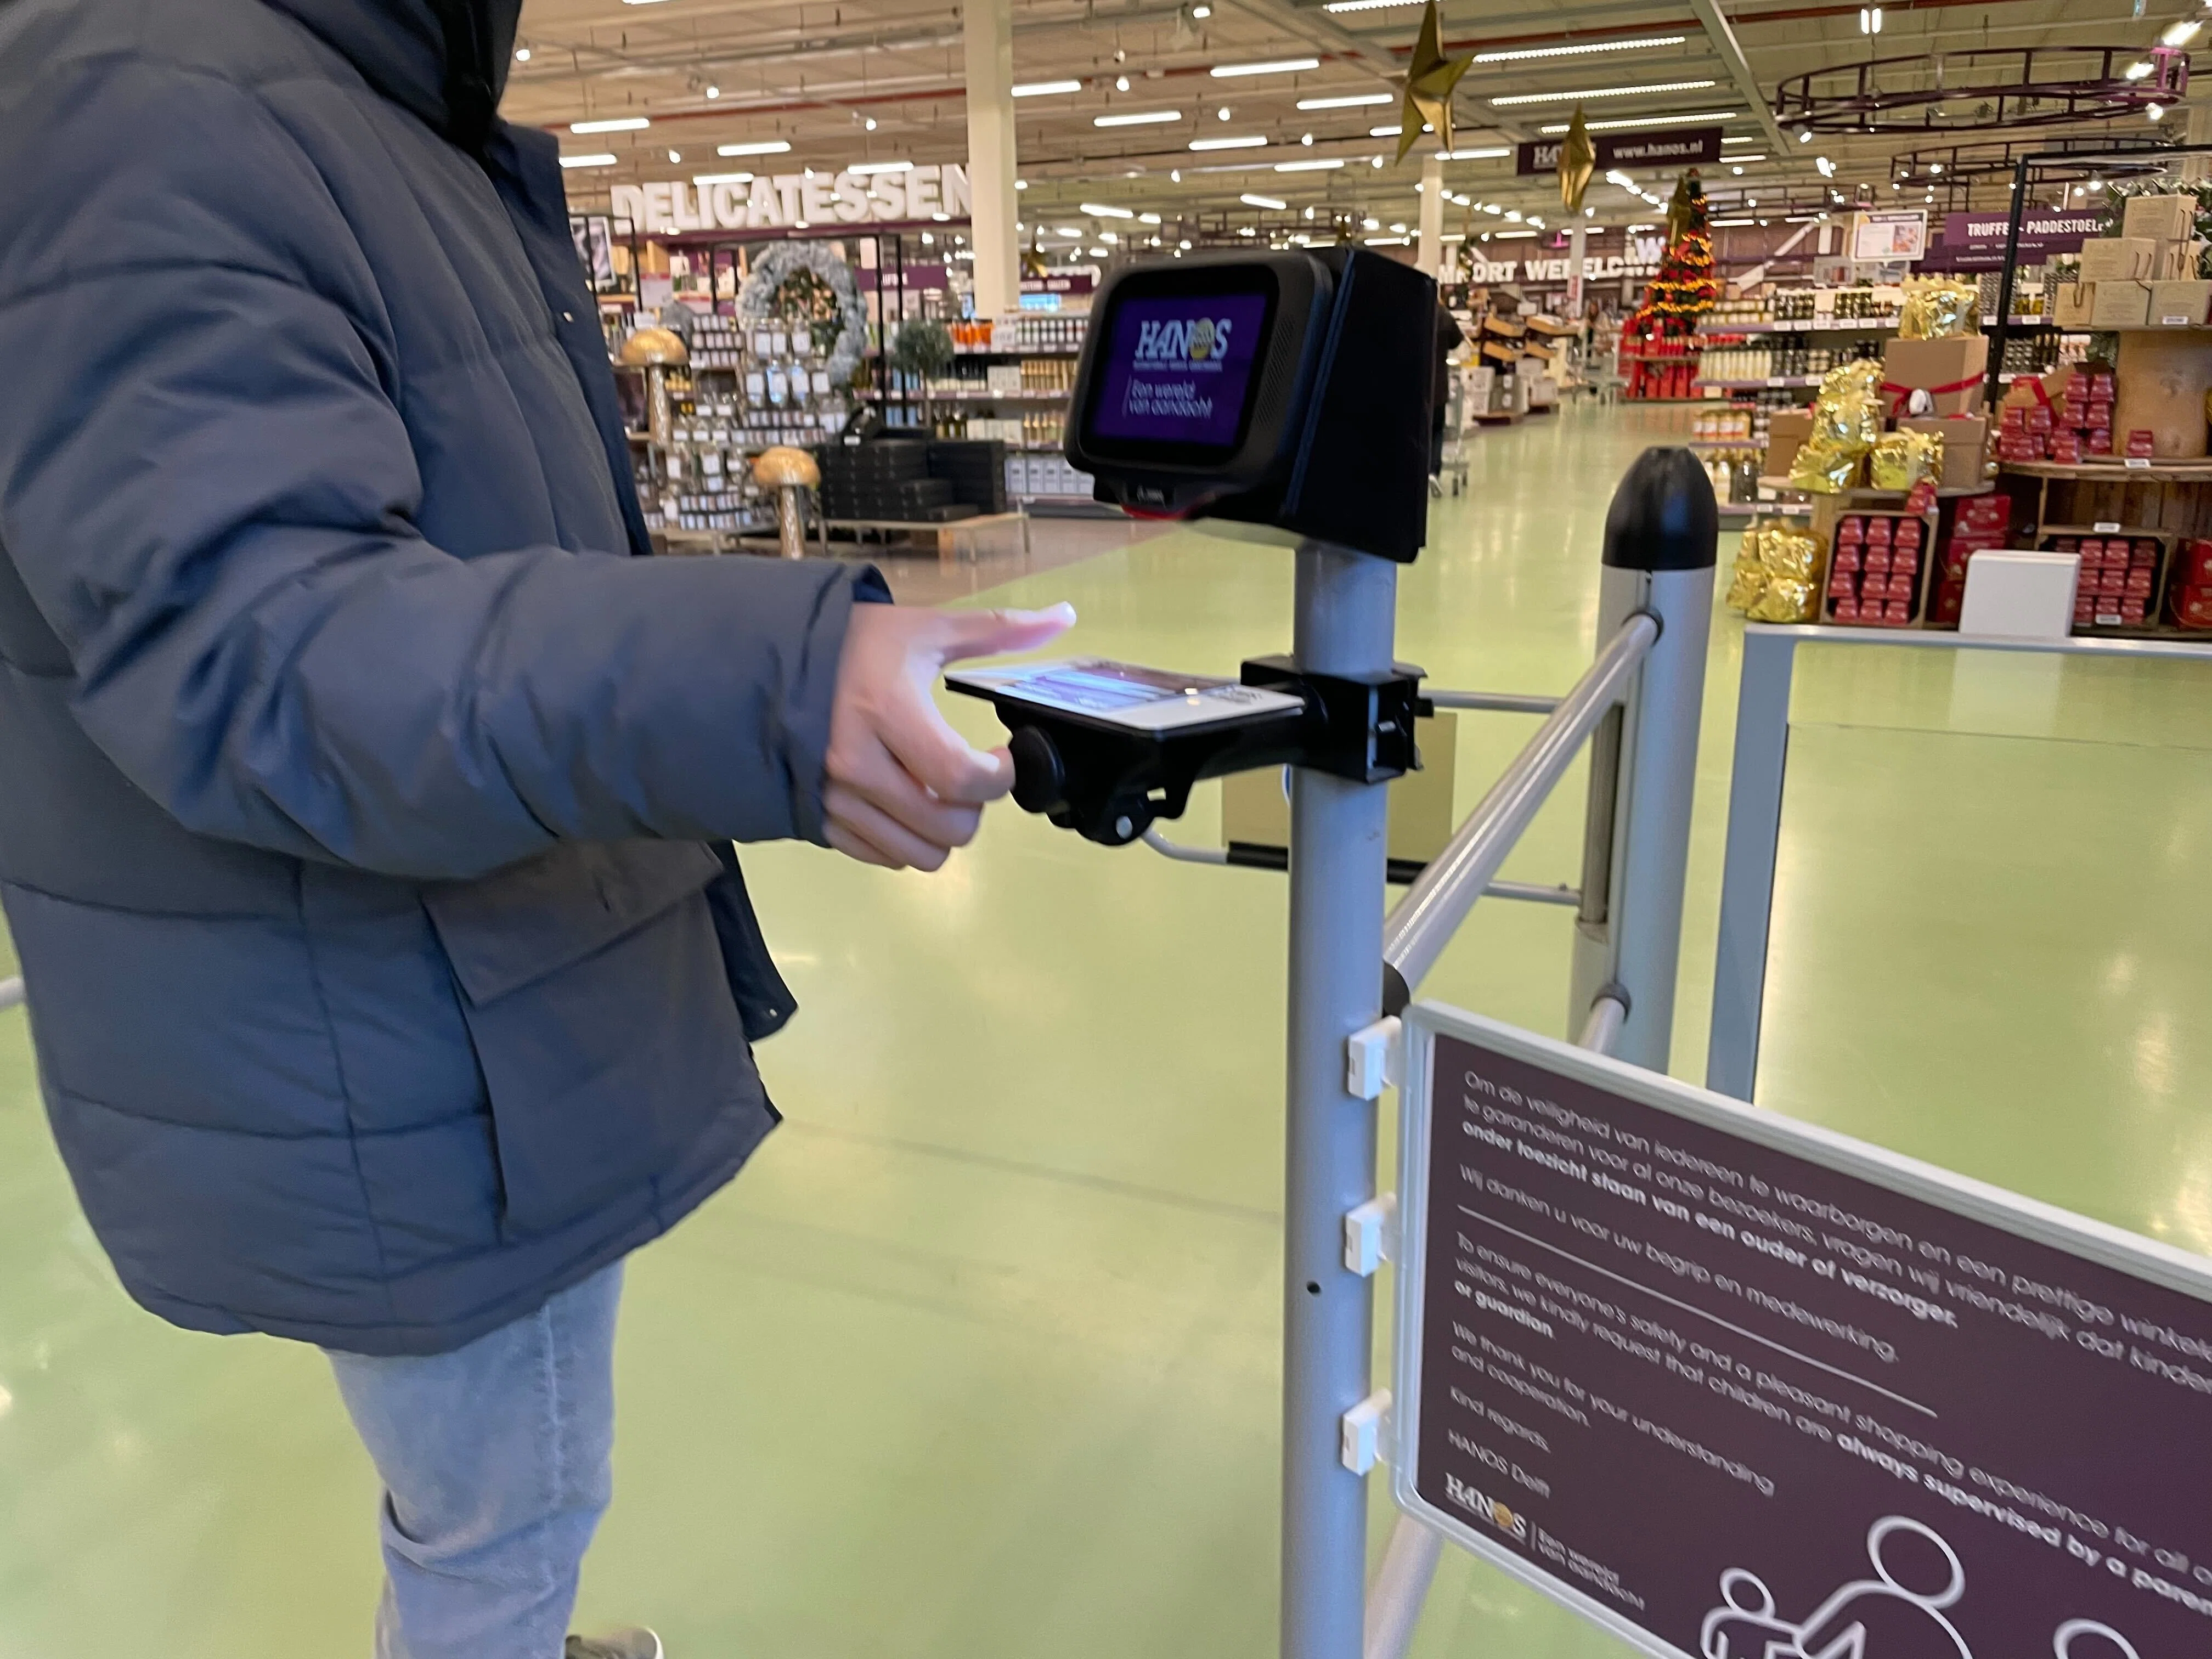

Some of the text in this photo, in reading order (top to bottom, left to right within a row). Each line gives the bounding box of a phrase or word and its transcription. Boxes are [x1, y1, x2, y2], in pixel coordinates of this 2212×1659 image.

[610, 163, 971, 236] DELICATESSEN
[1134, 317, 1232, 360] HANOS
[1459, 1163, 1483, 1192] Wij
[1486, 1178, 1551, 1218] danken
[1553, 1206, 1567, 1224] u
[1570, 1213, 1611, 1242] voor
[1612, 1232, 1643, 1255] uw
[1645, 1241, 1711, 1284] begrip
[1714, 1273, 1742, 1298] en
[1462, 1121, 1514, 1153] onder
[1516, 1138, 1588, 1182] toezicht
[1591, 1171, 1646, 1206] staan
[1651, 1194, 1690, 1223] van
[1694, 1212, 1736, 1241] een
[1740, 1230, 1808, 1268] ouder
[1812, 1257, 1837, 1280] of
[1463, 1093, 1480, 1115] te
[1482, 1105, 1584, 1156] garanderen
[1588, 1144, 1629, 1172] voor
[1632, 1163, 1652, 1182] al
[1655, 1171, 1705, 1200] onze
[1821, 1232, 1903, 1278] vragen
[1907, 1265, 1940, 1295] wij
[1944, 1279, 2071, 1342] vriendelijk
[2075, 1330, 2125, 1361] dat
[1464, 1070, 1496, 1097] Om
[1499, 1086, 1522, 1107] de
[1526, 1096, 1610, 1139] veiligheid
[1614, 1127, 1650, 1154] van
[1654, 1139, 1743, 1189] iedereen
[1750, 1174, 1770, 1198] te
[1774, 1186, 1913, 1252] waarborgen
[1918, 1240, 1951, 1266] en
[1956, 1255, 2006, 1286] een
[2012, 1274, 2115, 1326] prettige
[1454, 1279, 1473, 1299] or
[1450, 1385, 1485, 1417] Kind
[1451, 1345, 1485, 1373] and
[1452, 1320, 1776, 1498] We thank you for your understanding
[1457, 1231, 1475, 1255] To
[1476, 1245, 1532, 1281] ensure
[1534, 1271, 1627, 1325] everyone's
[1629, 1314, 1686, 1354] safety
[1689, 1341, 1733, 1372] and
[1735, 1362, 1752, 1382] a
[1756, 1370, 1851, 1425] pleasant
[1855, 1414, 1965, 1480] shopping
[1968, 1466, 2111, 1539] experience
[2113, 1525, 2152, 1557] for
[2153, 1547, 2190, 1575] all
[1448, 1427, 1509, 1476] HANOS
[1511, 1283, 1537, 1307] we
[1539, 1294, 1591, 1334] kindly
[1592, 1322, 1661, 1366] request
[1664, 1352, 1704, 1385] that
[1708, 1375, 1792, 1426] children
[1795, 1415, 1833, 1443] are
[1836, 1432, 1919, 1483] always
[1923, 1473, 2062, 1548] supervised
[2067, 1533, 2103, 1567] by
[2105, 1556, 2128, 1579] a
[1444, 1471, 1527, 1538] HANOS
